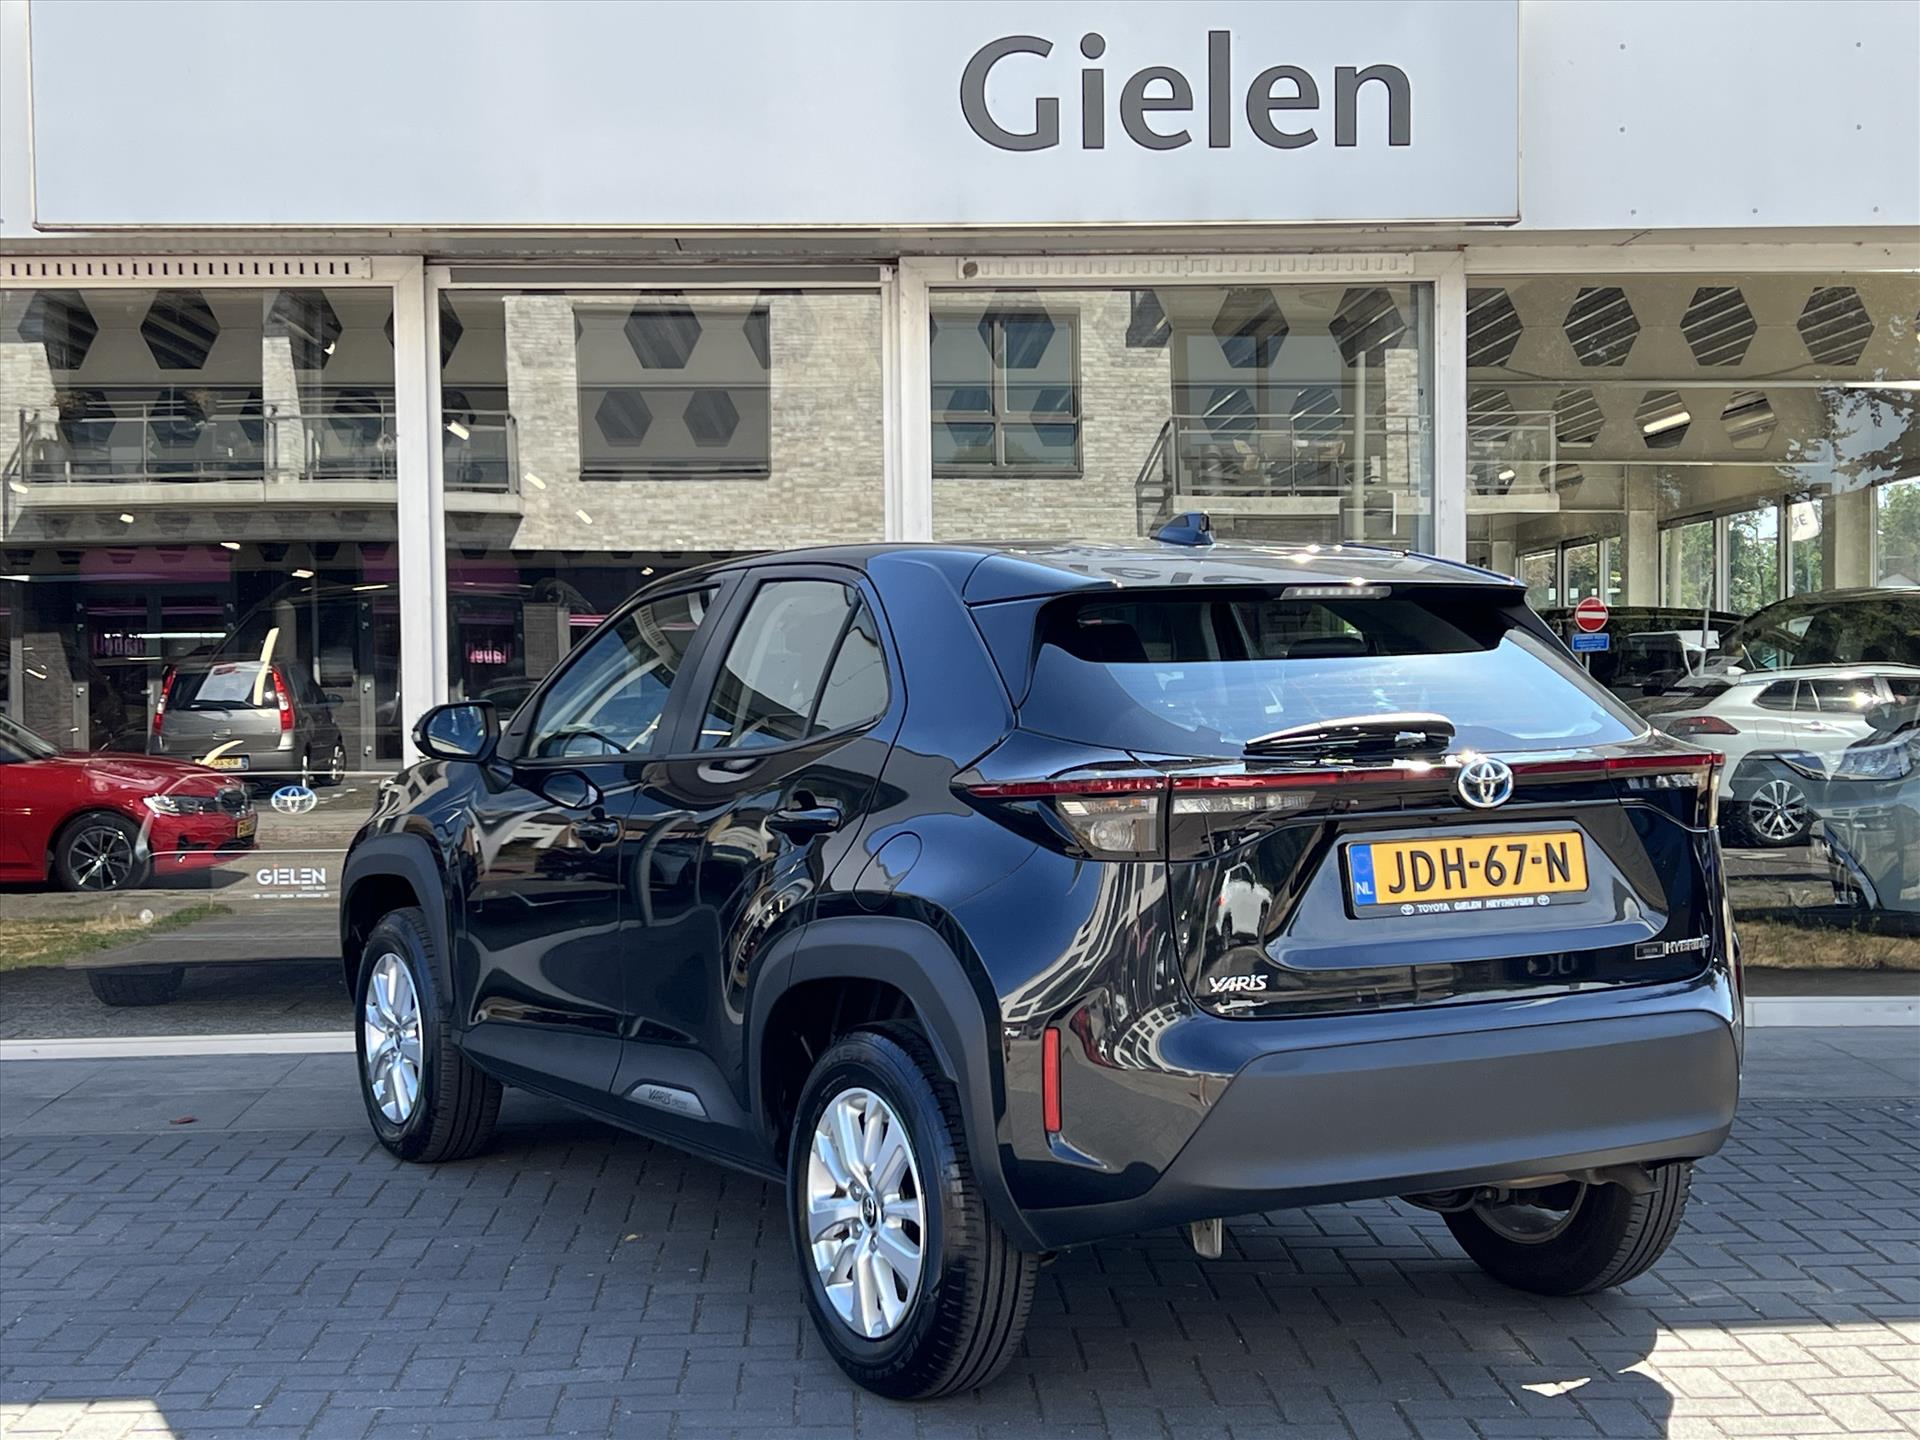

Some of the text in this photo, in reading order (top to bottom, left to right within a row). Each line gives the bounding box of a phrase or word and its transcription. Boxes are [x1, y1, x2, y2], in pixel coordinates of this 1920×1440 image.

[959, 29, 1412, 152] Gielen
[256, 865, 327, 886] GIELEN
[1388, 841, 1571, 894] JDH-67-N
[1354, 882, 1374, 895] NL
[1417, 903, 1451, 913] TOYOTA
[1454, 900, 1482, 911] GIELEN
[1208, 974, 1269, 993] YARIS
